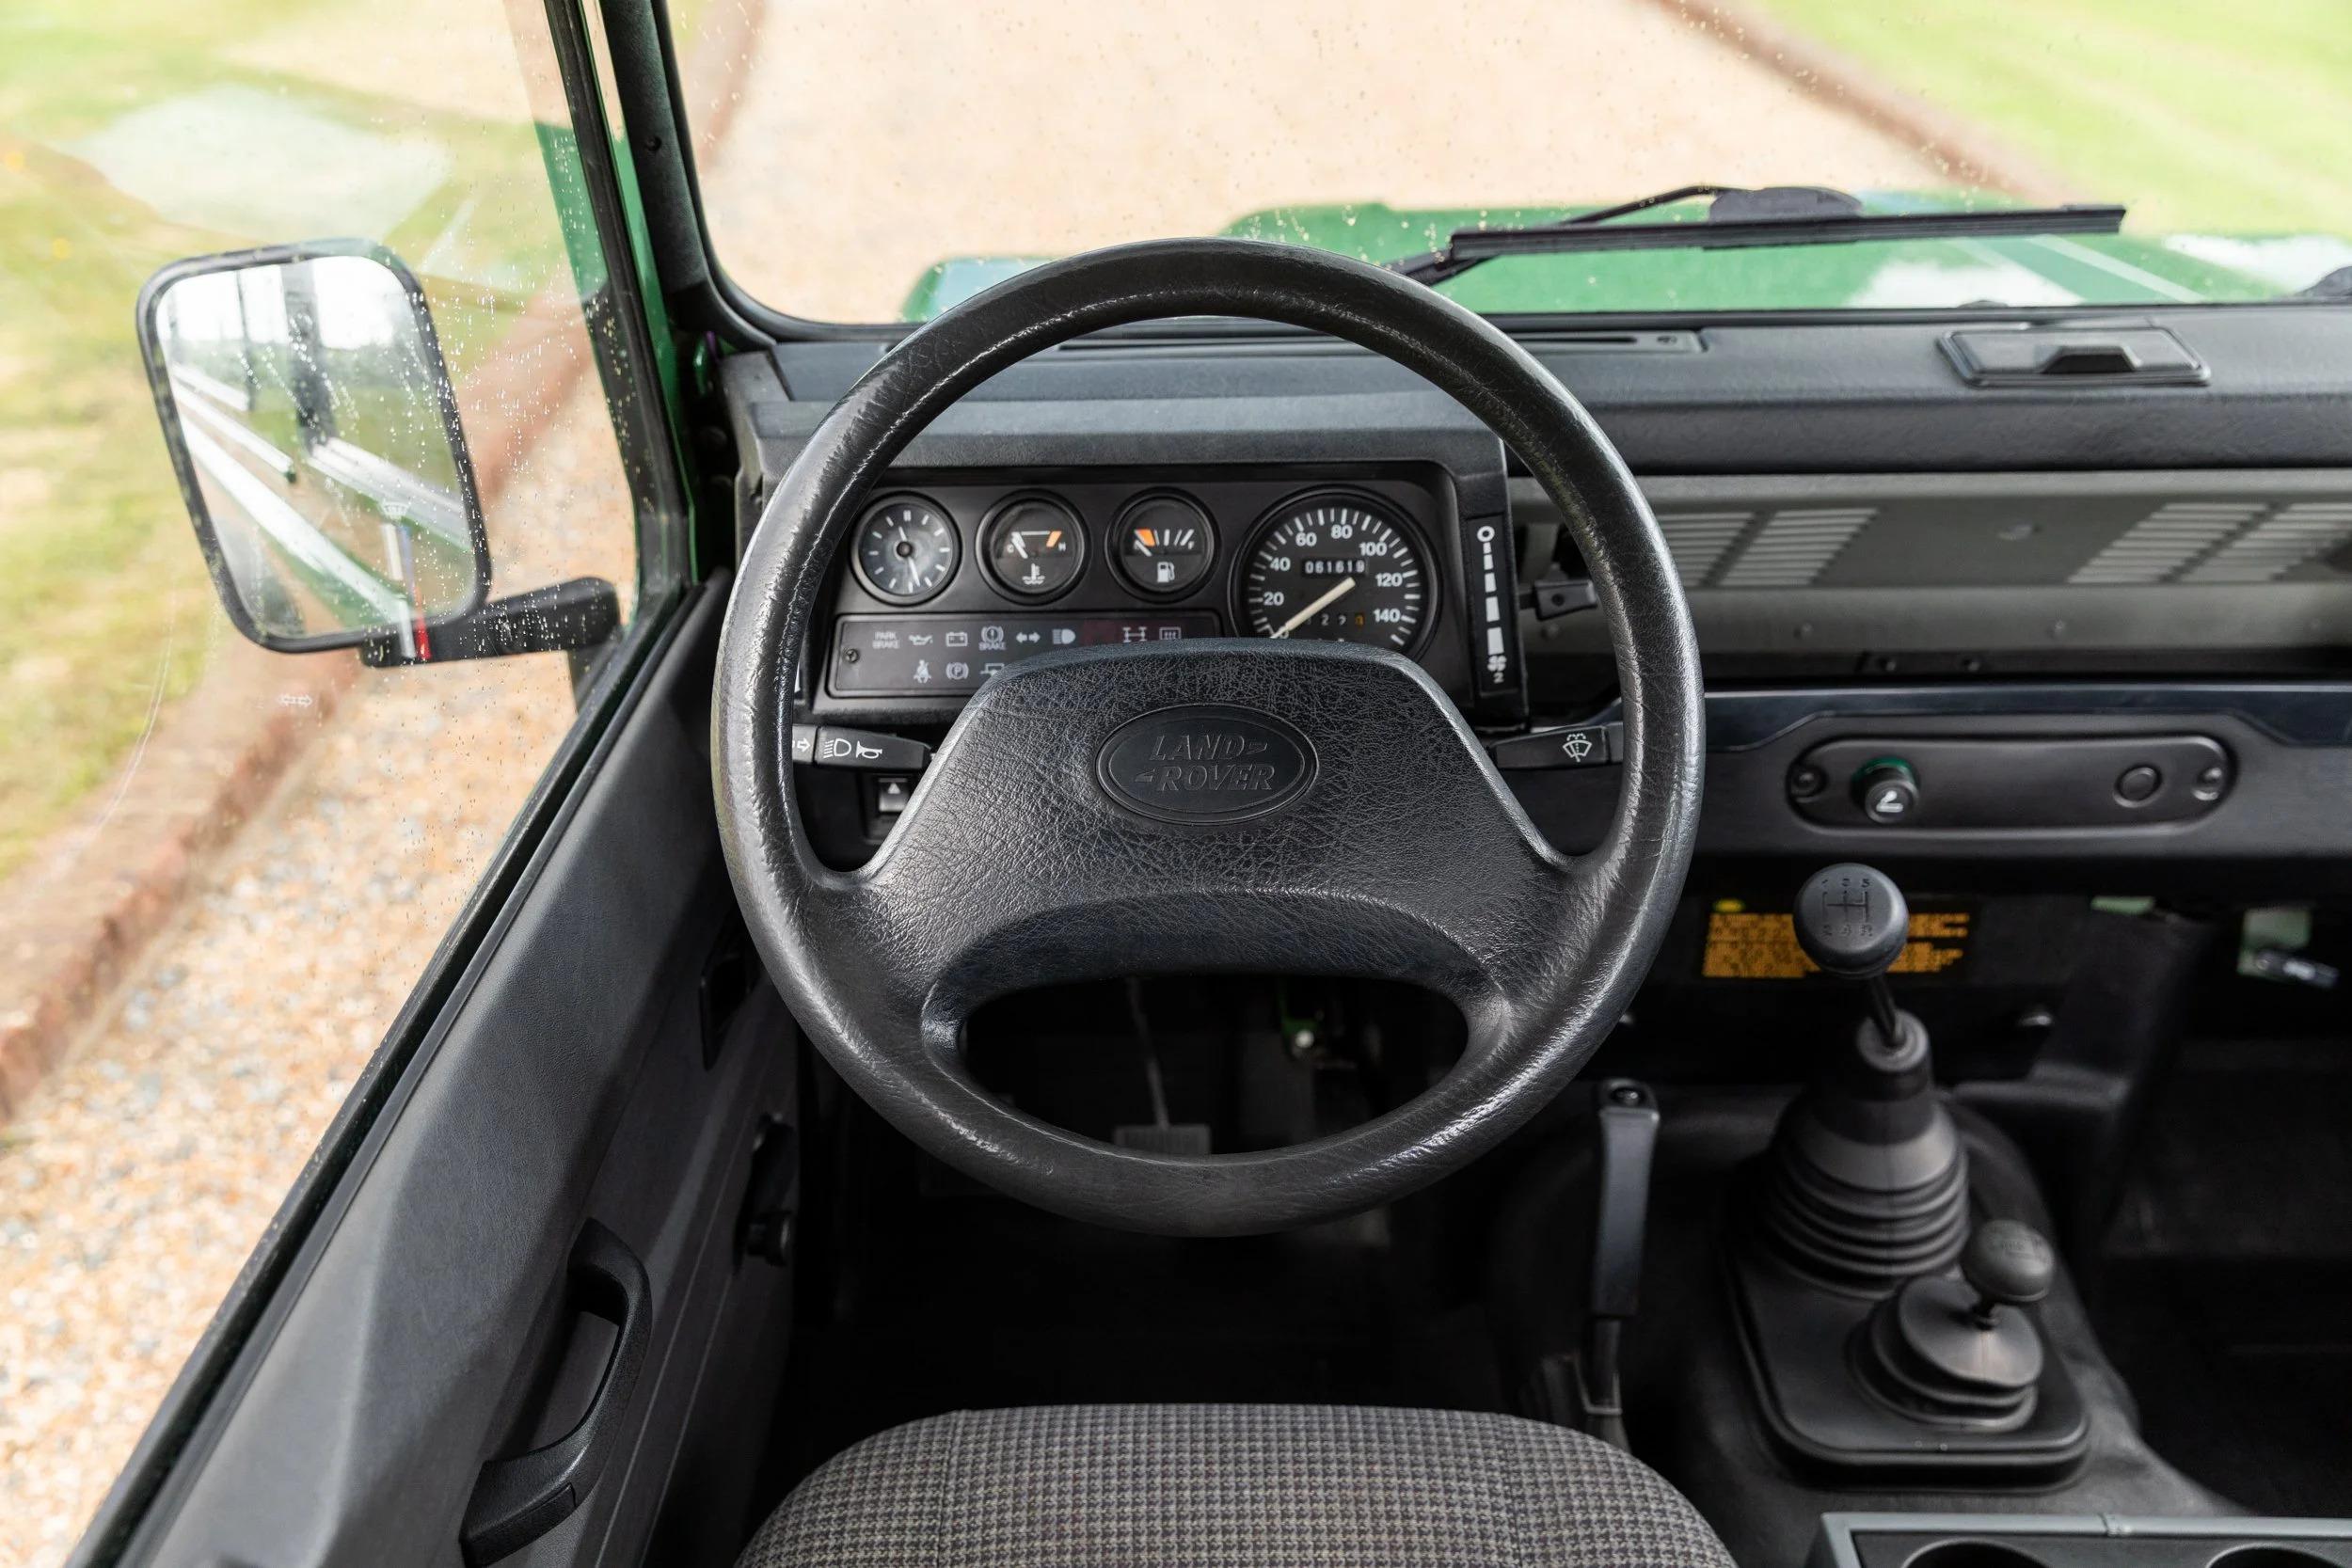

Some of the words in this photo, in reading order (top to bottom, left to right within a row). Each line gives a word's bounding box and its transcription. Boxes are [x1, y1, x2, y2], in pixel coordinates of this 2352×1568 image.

[1295, 532, 1317, 546] 60
[1330, 525, 1353, 539] 80
[1058, 542, 1067, 552] H
[1359, 542, 1388, 556] 100
[1270, 557, 1291, 571] 40
[1375, 573, 1403, 587] 120
[1263, 592, 1284, 606] 20
[1374, 609, 1401, 623] 140
[875, 631, 897, 640] PARK
[872, 640, 900, 649] BRAKE
[978, 642, 1006, 651] BRAKE
[1493, 672, 1504, 684] 2
[1149, 734, 1245, 760] LAND
[1156, 764, 1275, 791] ROVER
